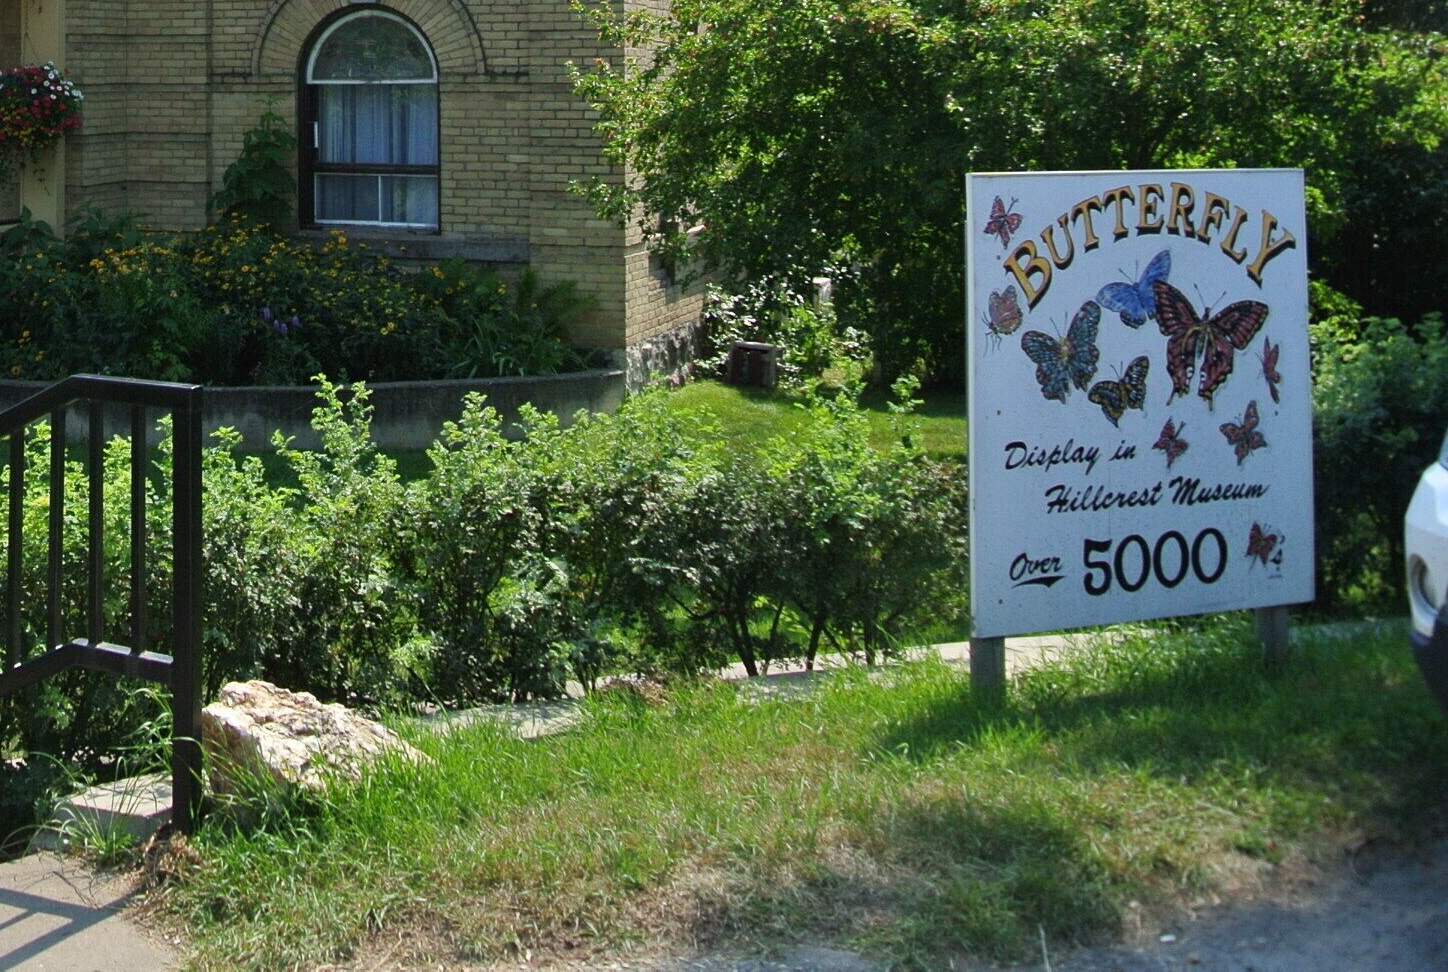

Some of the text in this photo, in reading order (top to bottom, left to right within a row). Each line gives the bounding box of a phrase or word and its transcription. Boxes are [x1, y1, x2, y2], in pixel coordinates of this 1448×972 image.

[1003, 181, 1296, 310] BUTTERFLY
[1004, 438, 1136, 475] Display in
[1045, 475, 1271, 514] Hillcrest Museum
[1009, 552, 1063, 582] Over
[1083, 527, 1228, 596] 5000
